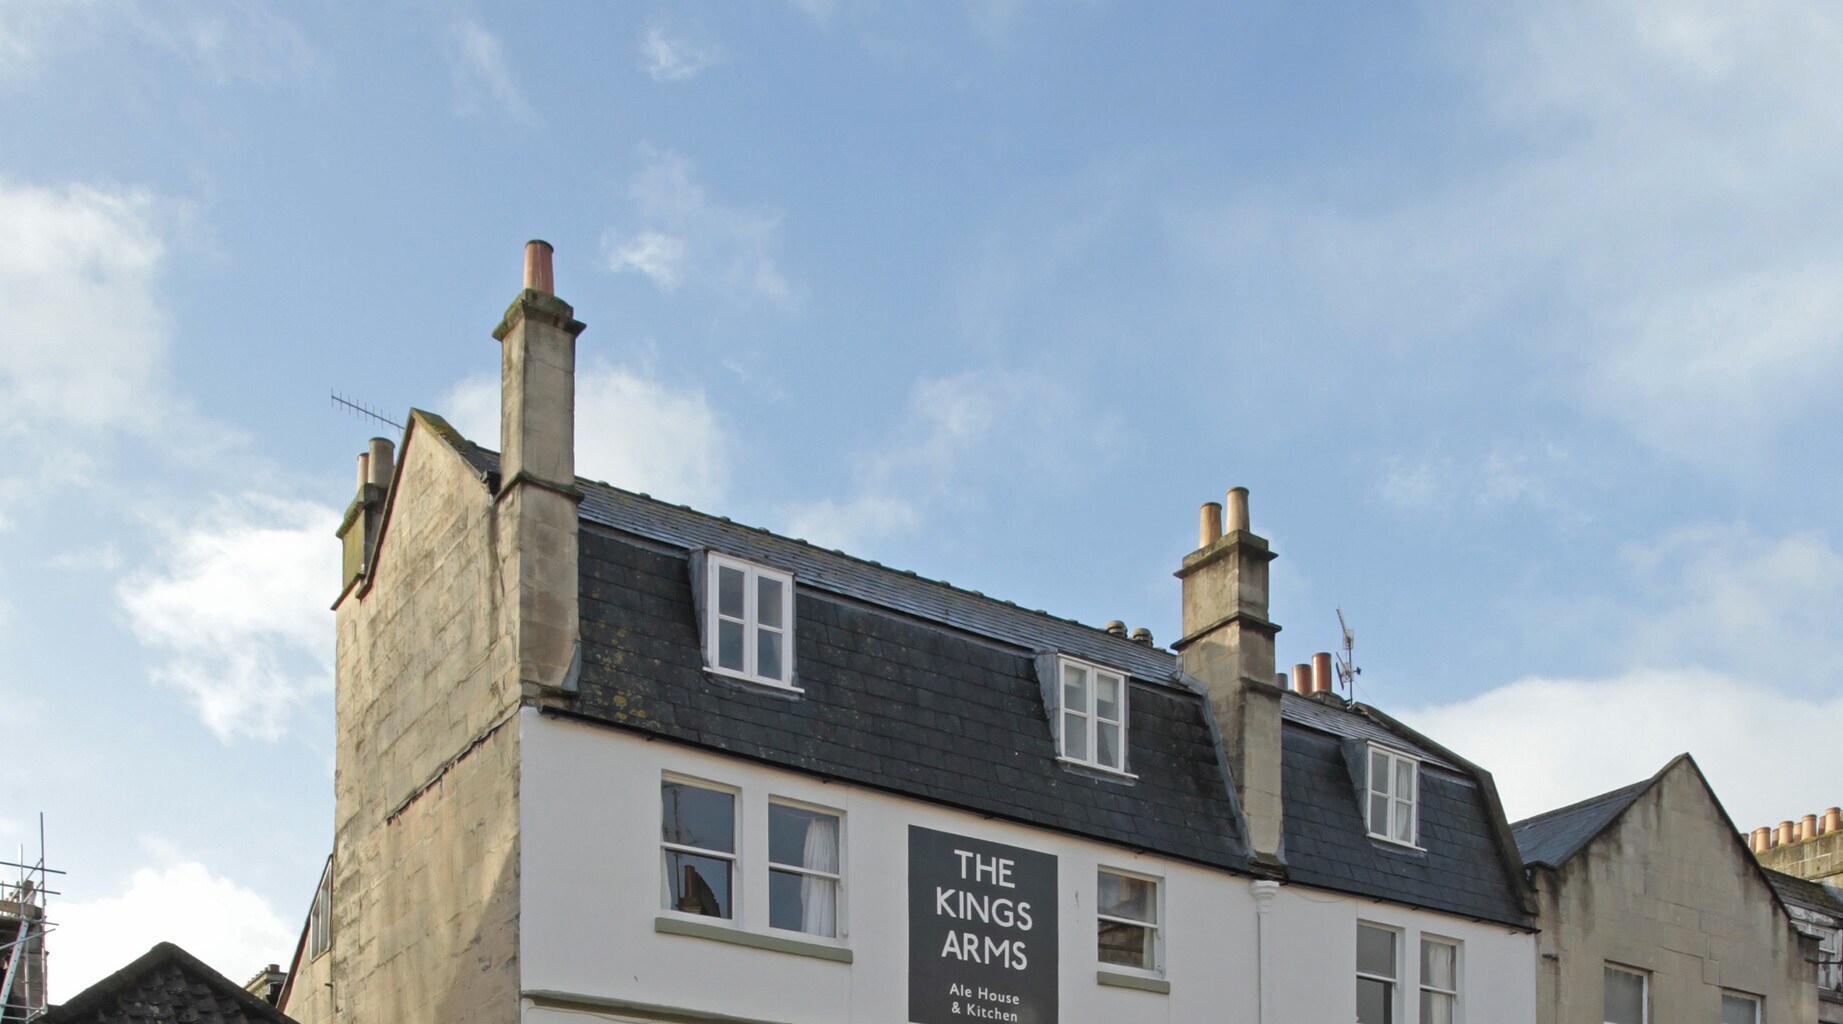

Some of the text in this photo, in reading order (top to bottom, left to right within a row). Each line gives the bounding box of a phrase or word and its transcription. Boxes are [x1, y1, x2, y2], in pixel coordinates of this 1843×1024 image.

[954, 849, 1016, 889] THE
[936, 886, 1033, 931] KINGS
[941, 929, 1028, 971] ARMS
[950, 982, 1020, 1005] Ale House
[951, 1001, 1018, 1023] & Kitchen
